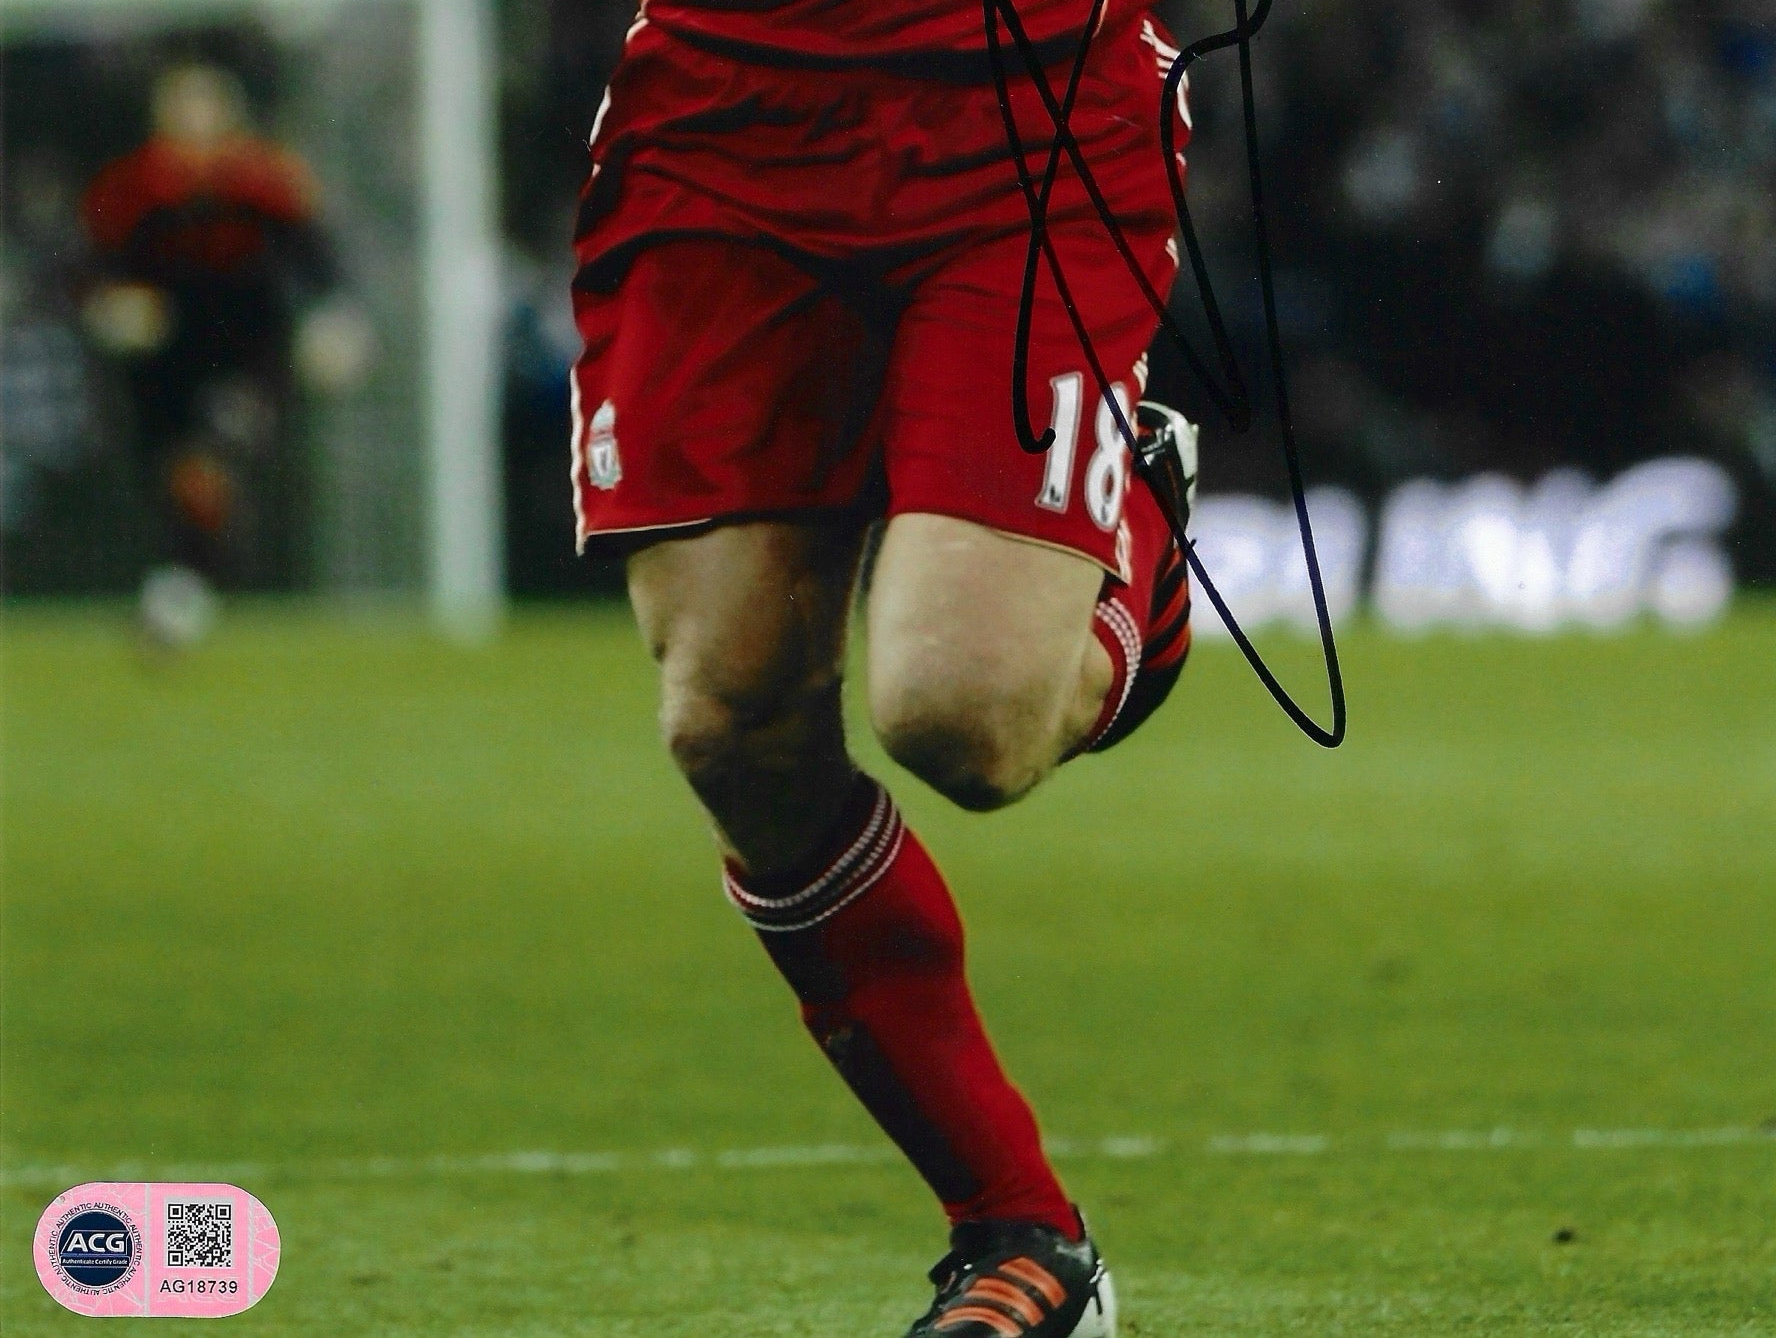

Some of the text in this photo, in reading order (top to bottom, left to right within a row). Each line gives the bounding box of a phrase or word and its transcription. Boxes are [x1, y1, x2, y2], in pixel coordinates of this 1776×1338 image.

[1034, 370, 1131, 533] 18
[48, 1202, 143, 1296] AUTHENTIC AUTHENTIC AUTHENTIC AUTHENTIC AUTHENTIC AUTHENTIC
[66, 1232, 125, 1253] ACG
[159, 1279, 238, 1294] AG18739
